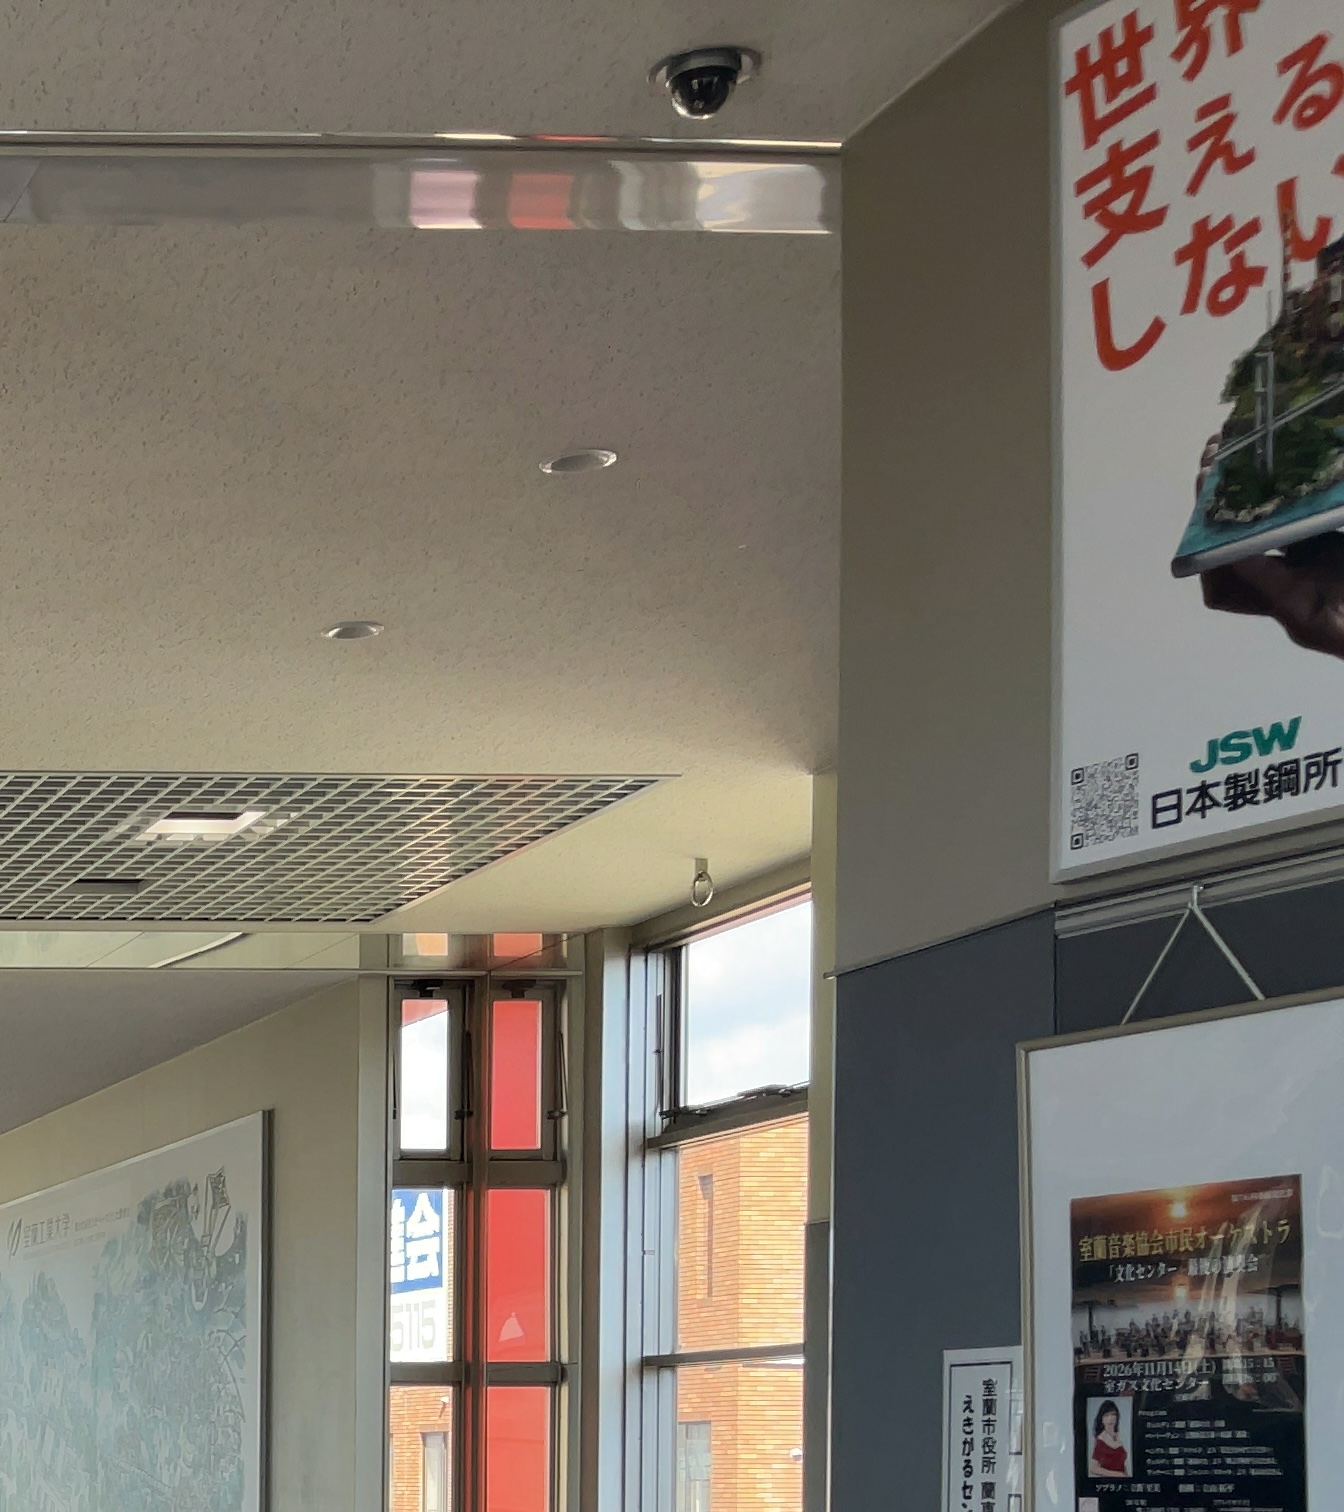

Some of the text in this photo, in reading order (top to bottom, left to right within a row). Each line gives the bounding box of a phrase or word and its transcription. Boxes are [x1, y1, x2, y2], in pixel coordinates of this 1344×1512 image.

[1189, 715, 1303, 774] JSW
[1150, 746, 1344, 830] 日本製鋼所
[981, 1378, 998, 1475] 室蘭市役所
